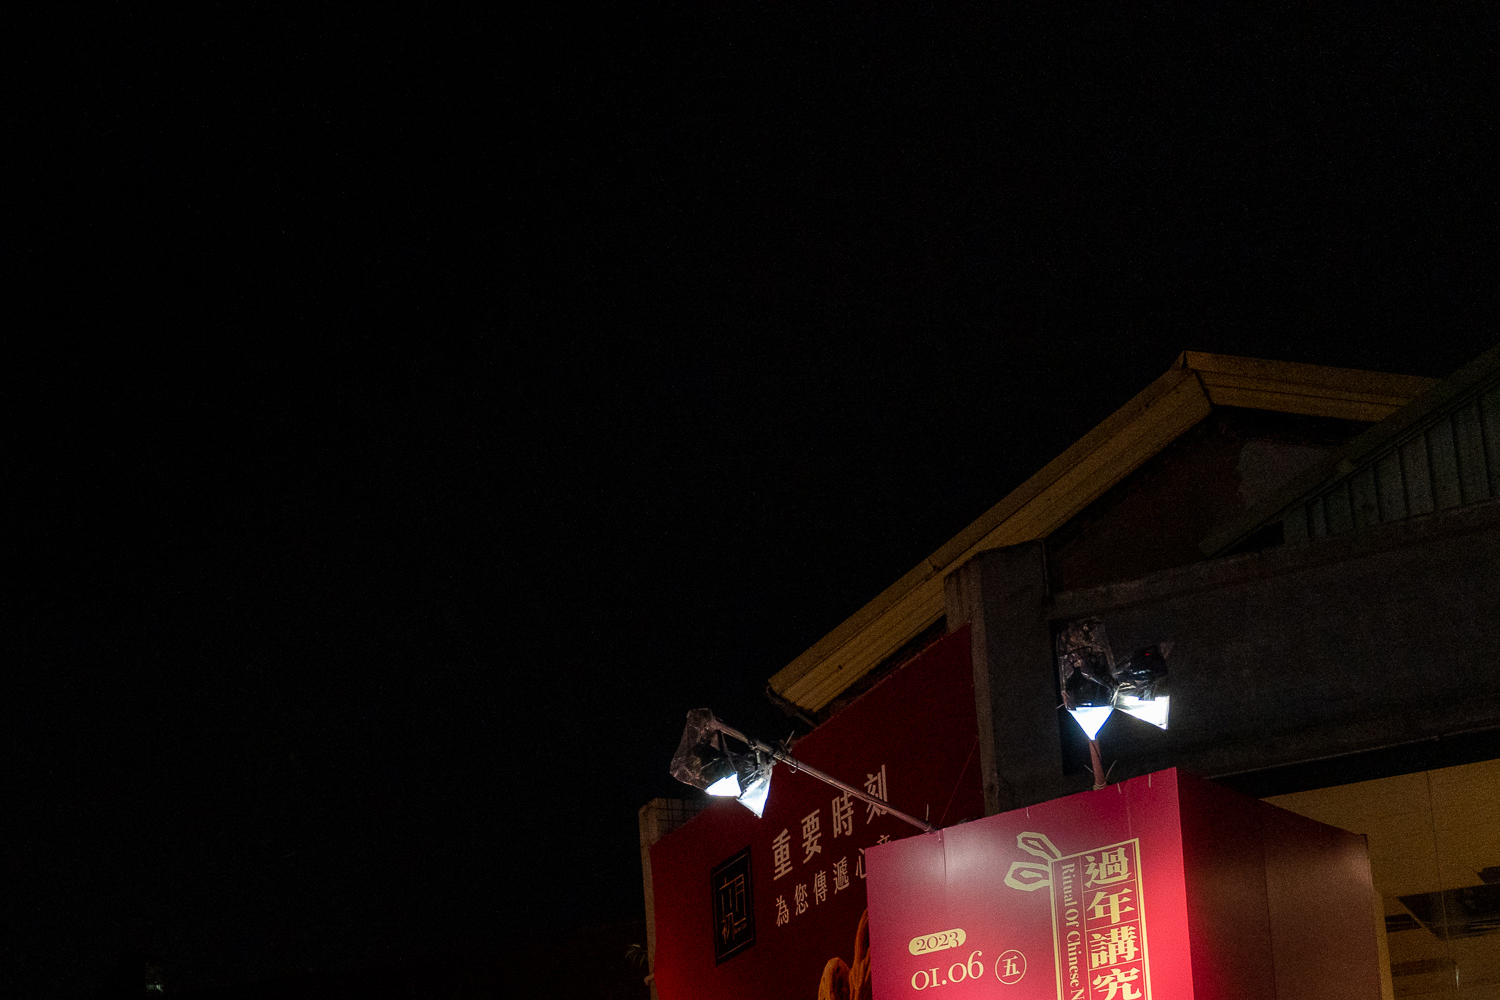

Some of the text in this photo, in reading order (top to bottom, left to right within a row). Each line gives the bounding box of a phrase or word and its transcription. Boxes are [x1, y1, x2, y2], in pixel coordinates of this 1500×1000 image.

[772, 763, 888, 881] 重要時刻
[775, 834, 892, 927] 為您傳遞心
[1061, 863, 1078, 907] Ritual
[1064, 908, 1081, 927] Of
[916, 931, 960, 953] 2023
[1066, 928, 1085, 989] Chinese
[911, 950, 1021, 990] 01.06 五
